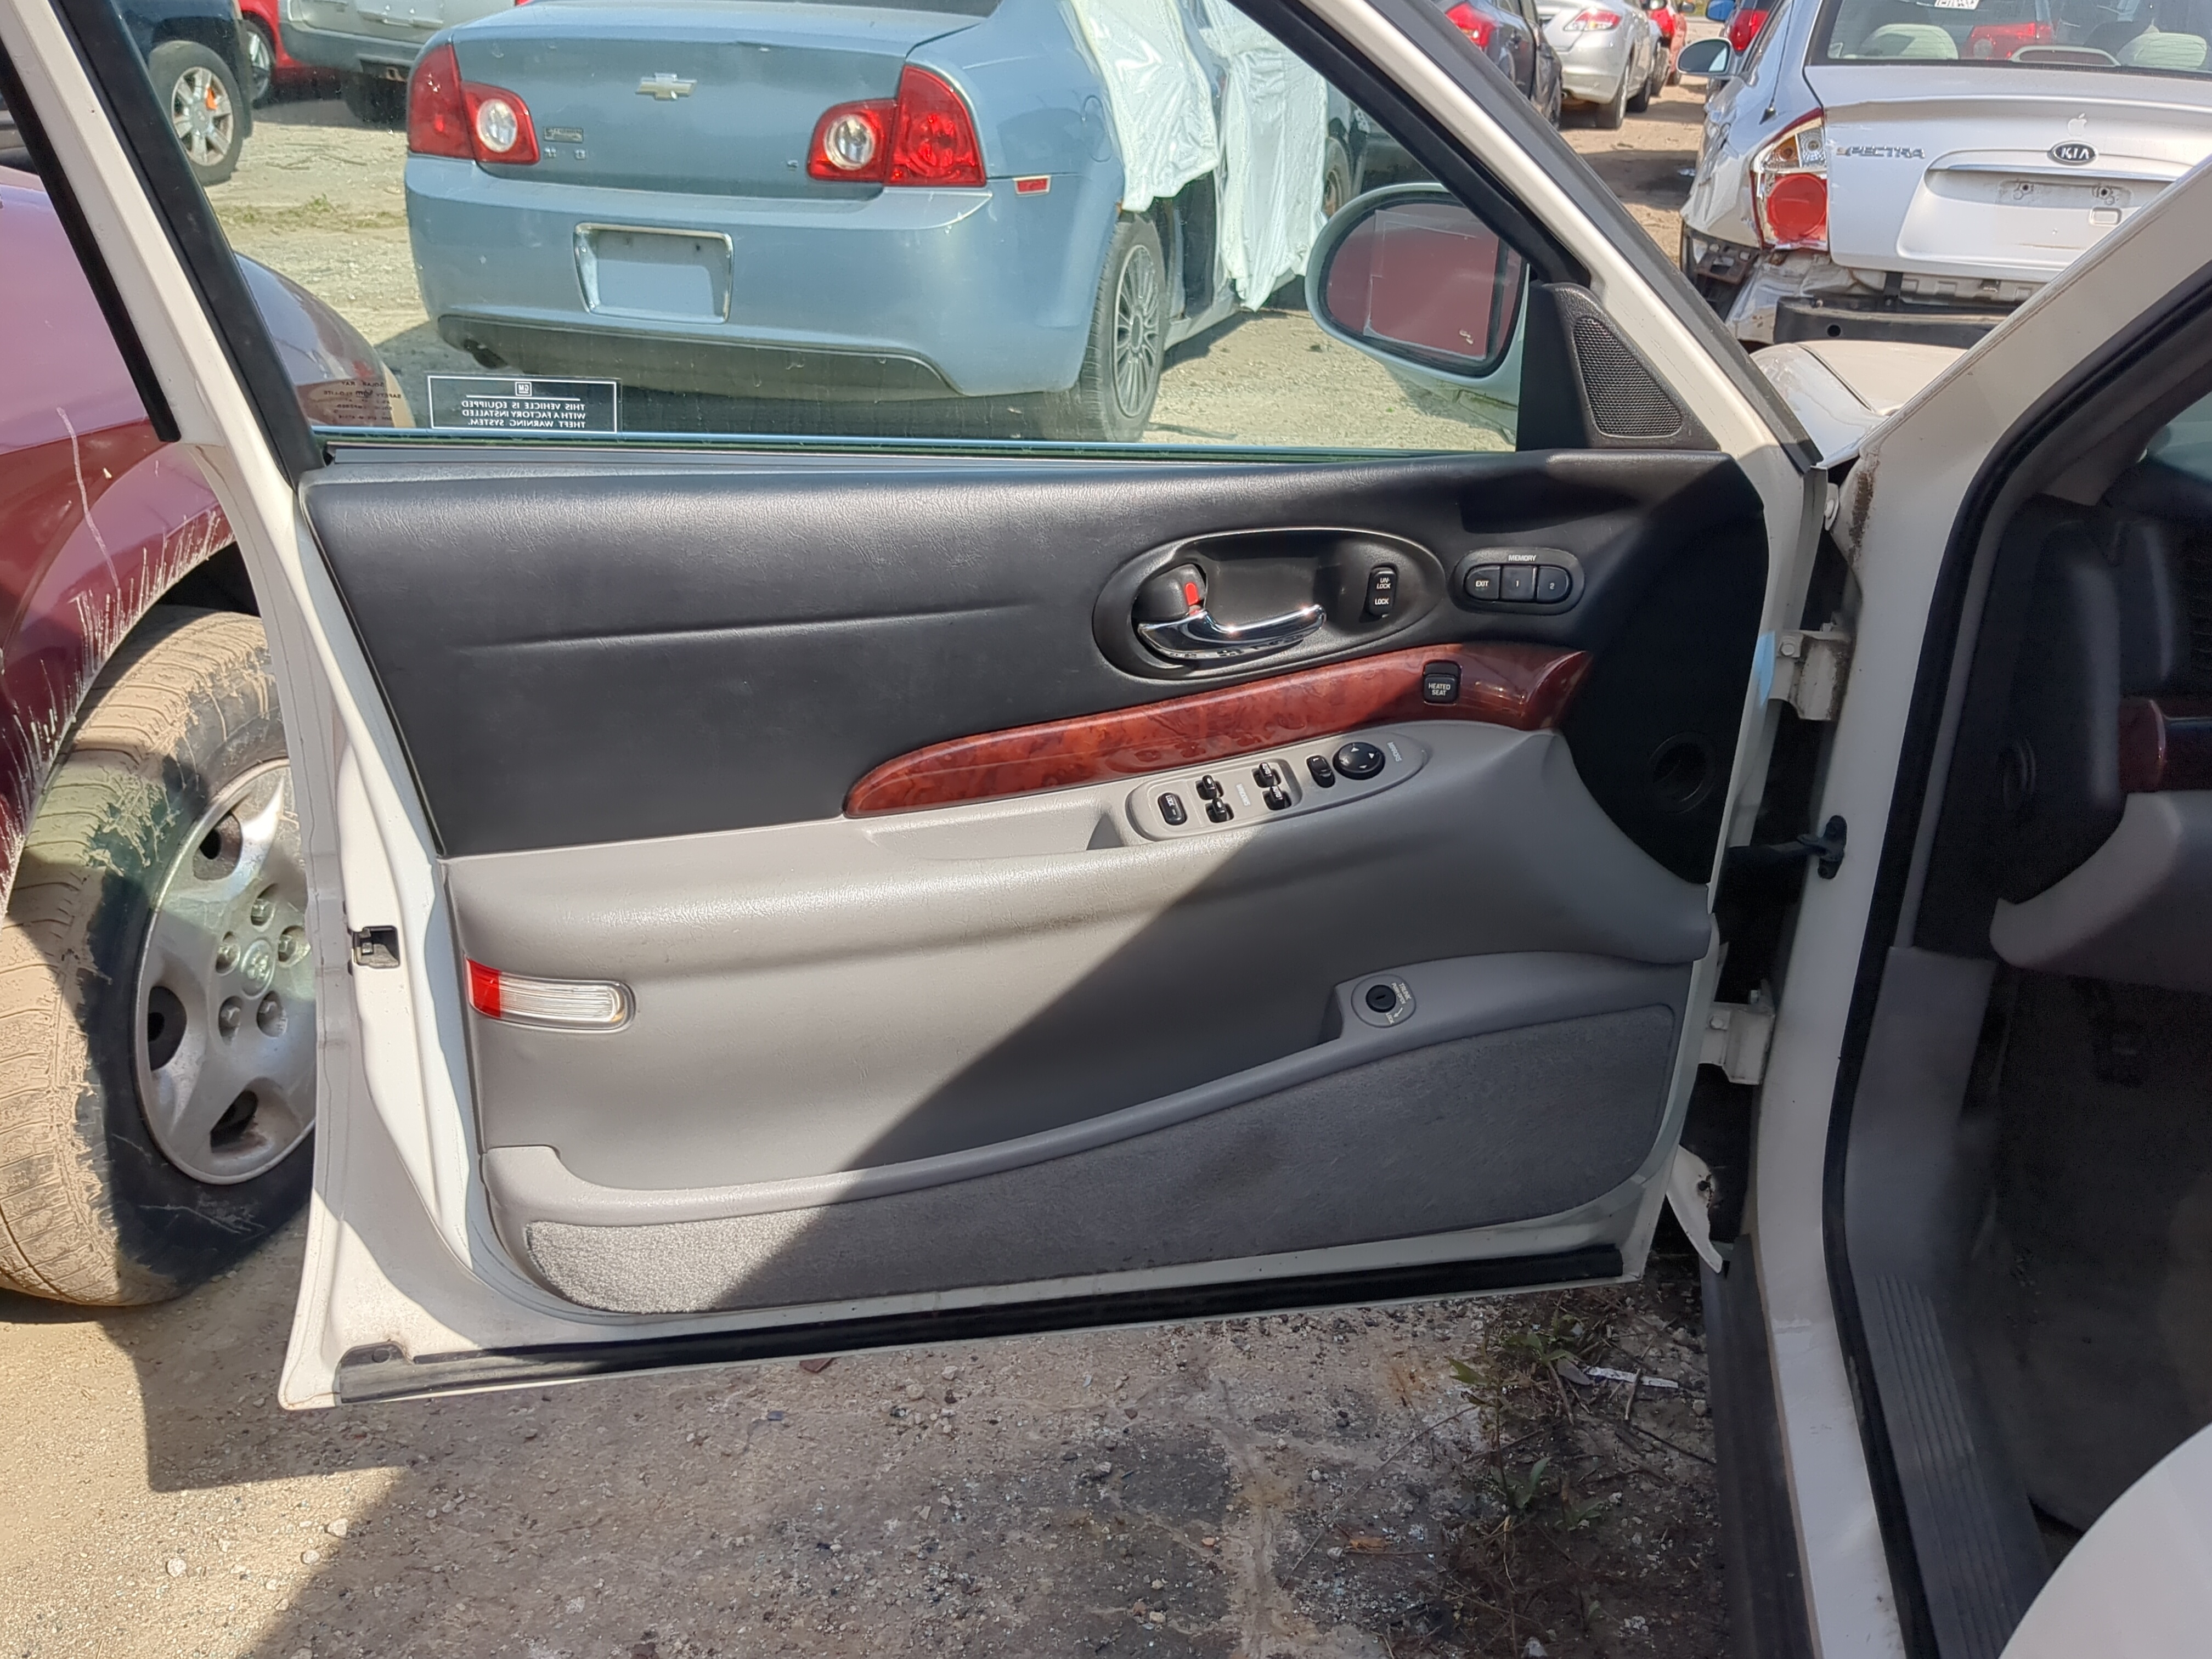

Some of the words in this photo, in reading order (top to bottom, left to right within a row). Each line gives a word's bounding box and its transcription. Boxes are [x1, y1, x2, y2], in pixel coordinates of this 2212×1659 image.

[2061, 147, 2089, 159] KIA
[1387, 742, 1402, 762] MIRRORS
[1165, 795, 1175, 806] LOCK
[1236, 783, 1251, 806] WINDOWS
[1391, 983, 1400, 994] PUSH
[1397, 993, 1406, 1005] OPEN
[1398, 983, 1412, 1000] TRUNK
[1386, 1012, 1395, 1024] LOCK
